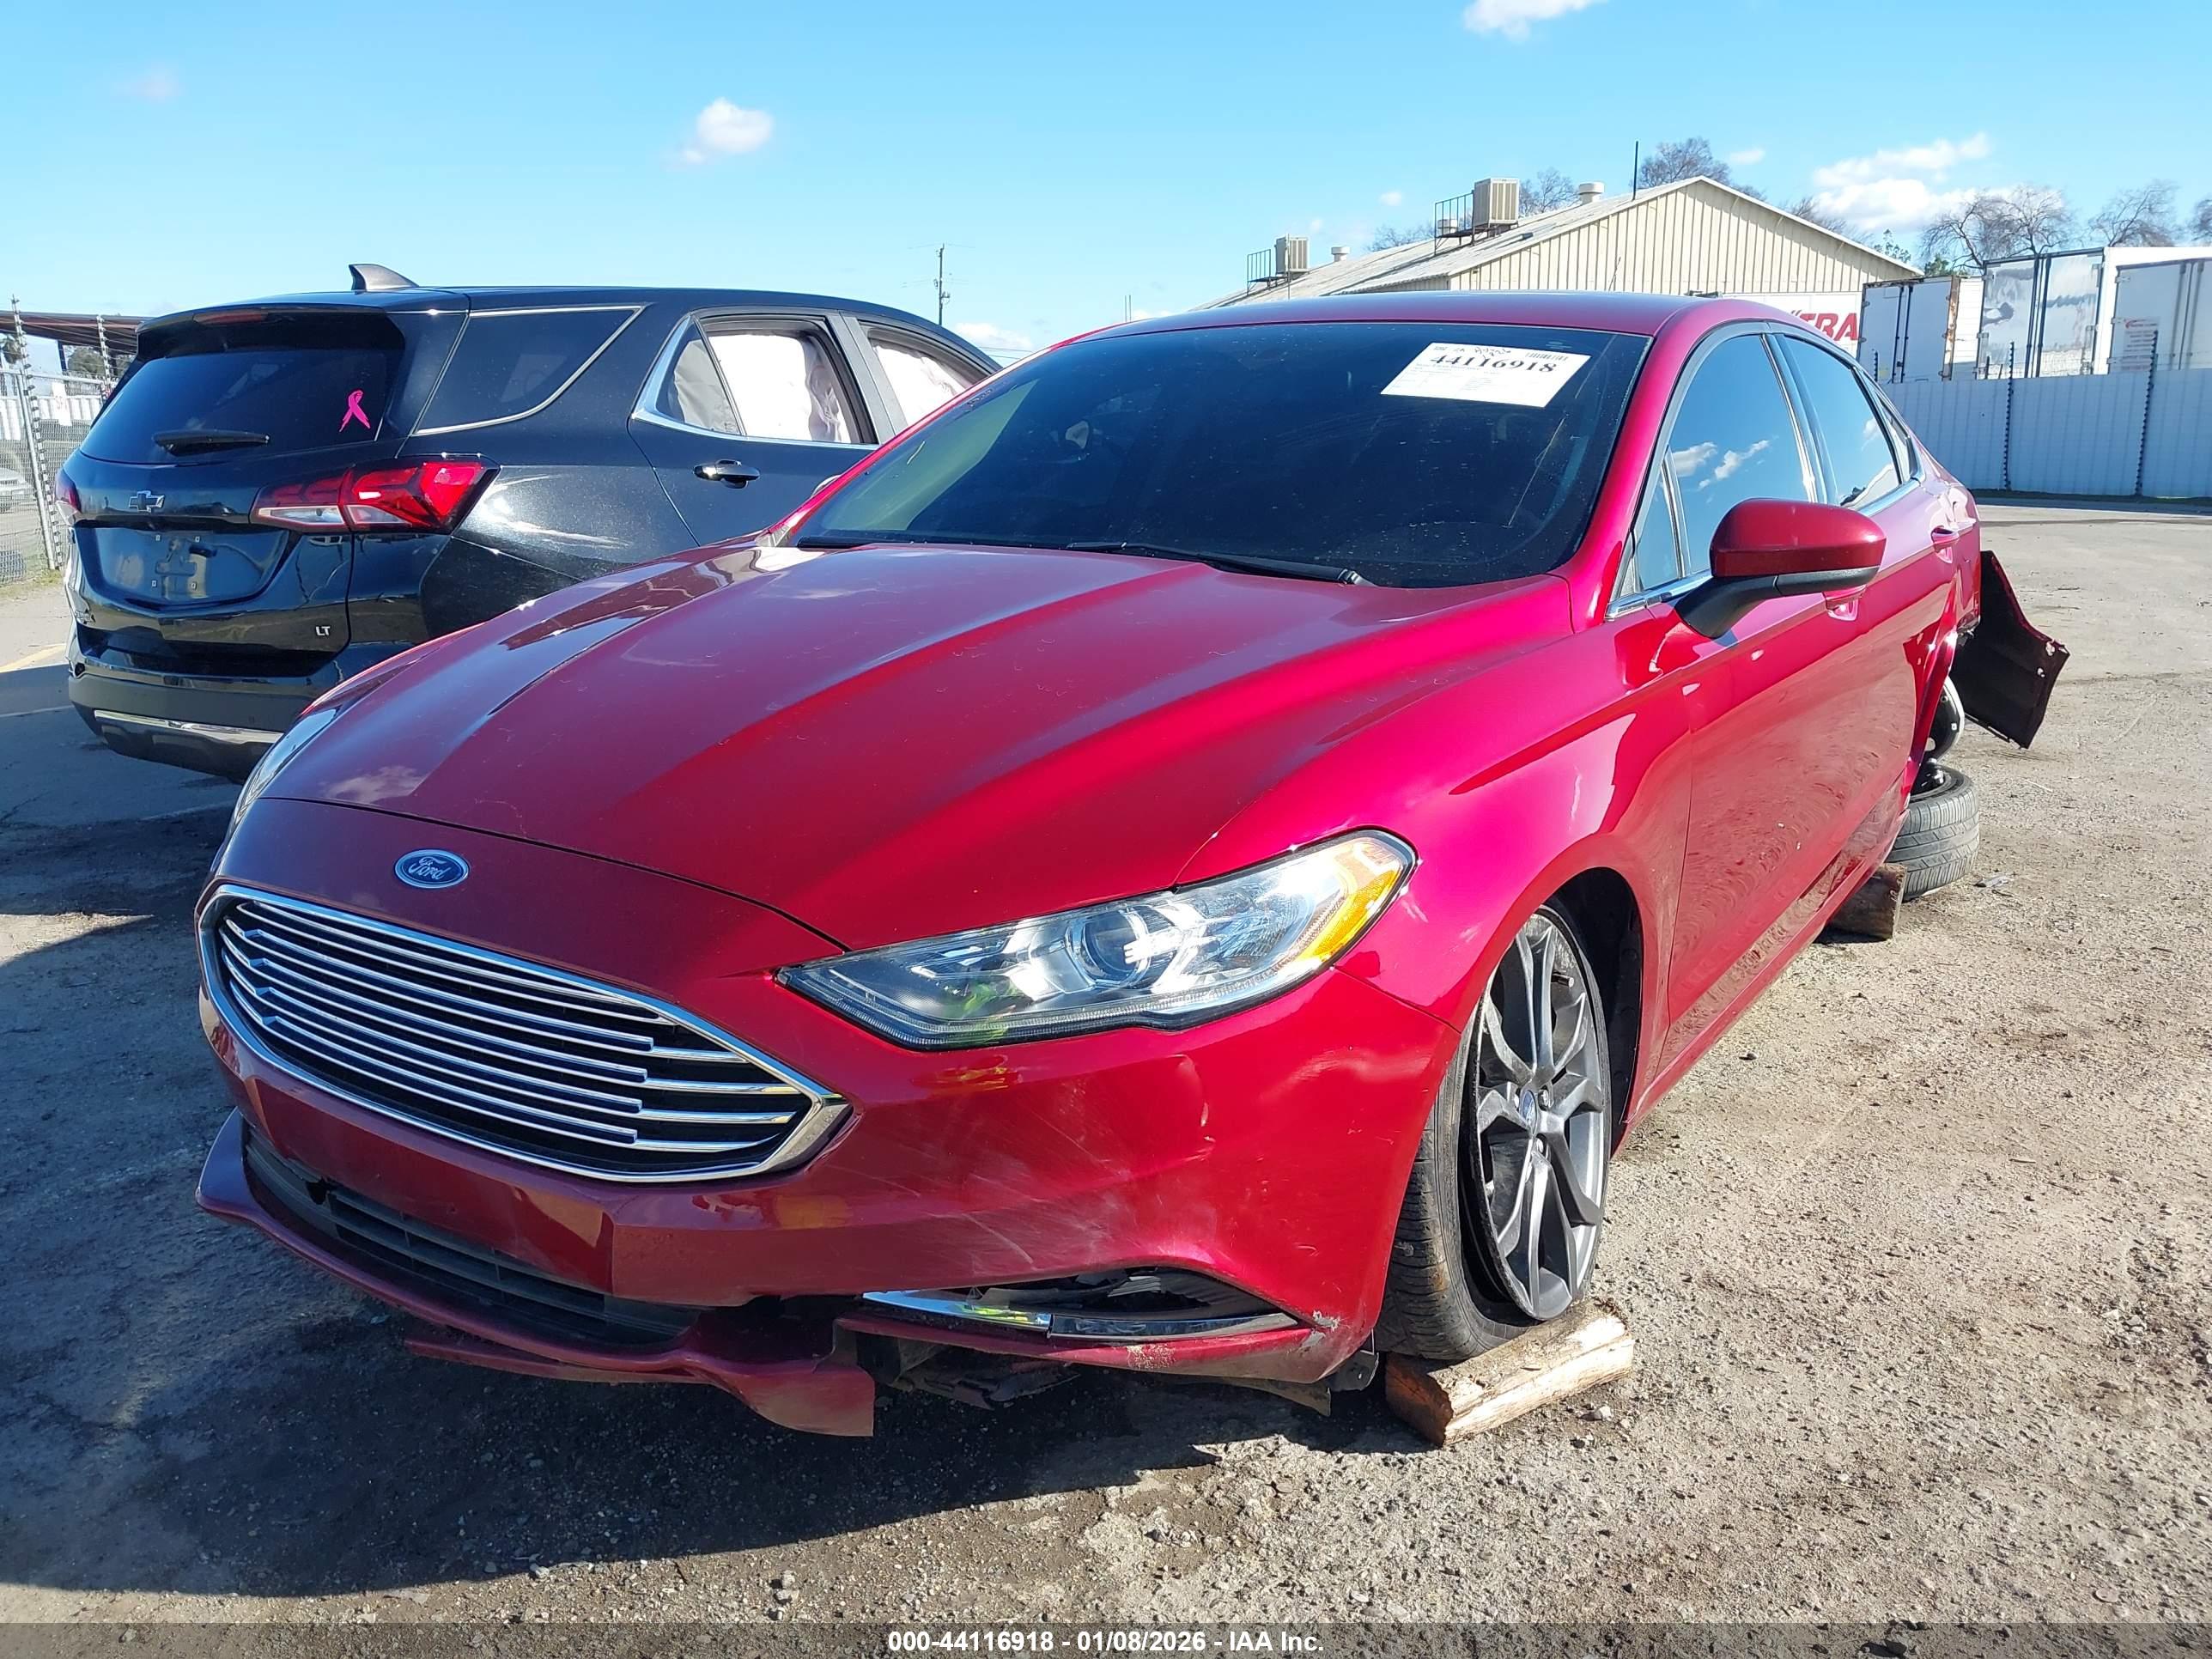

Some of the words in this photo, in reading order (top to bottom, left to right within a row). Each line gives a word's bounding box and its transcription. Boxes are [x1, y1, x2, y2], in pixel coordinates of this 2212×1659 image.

[1431, 355, 1557, 373] 44116918
[316, 626, 331, 636] LT
[408, 856, 452, 880] Ford
